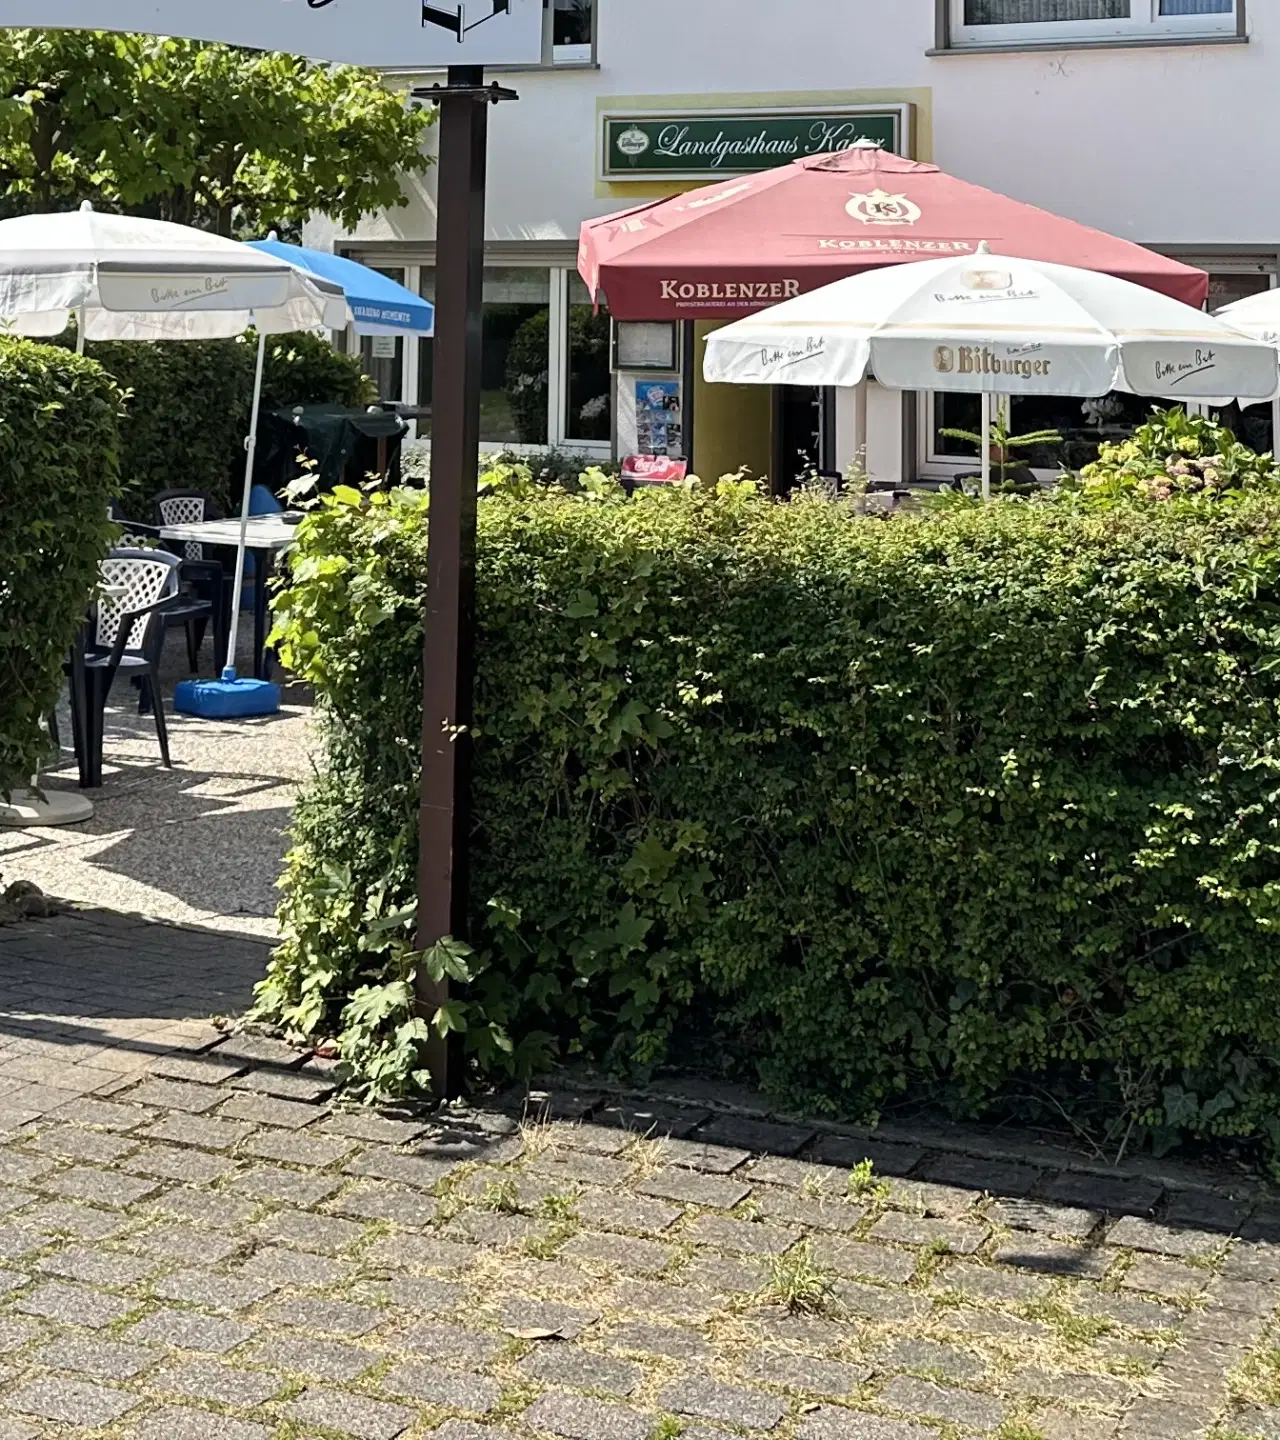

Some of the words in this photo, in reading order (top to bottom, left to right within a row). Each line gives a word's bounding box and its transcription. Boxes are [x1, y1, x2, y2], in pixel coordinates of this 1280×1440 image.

[654, 124, 799, 167] Landgasthaus
[817, 239, 973, 252] KOBLENZER
[660, 279, 802, 300] KOBLENZER
[958, 345, 1051, 379] Bitburger
